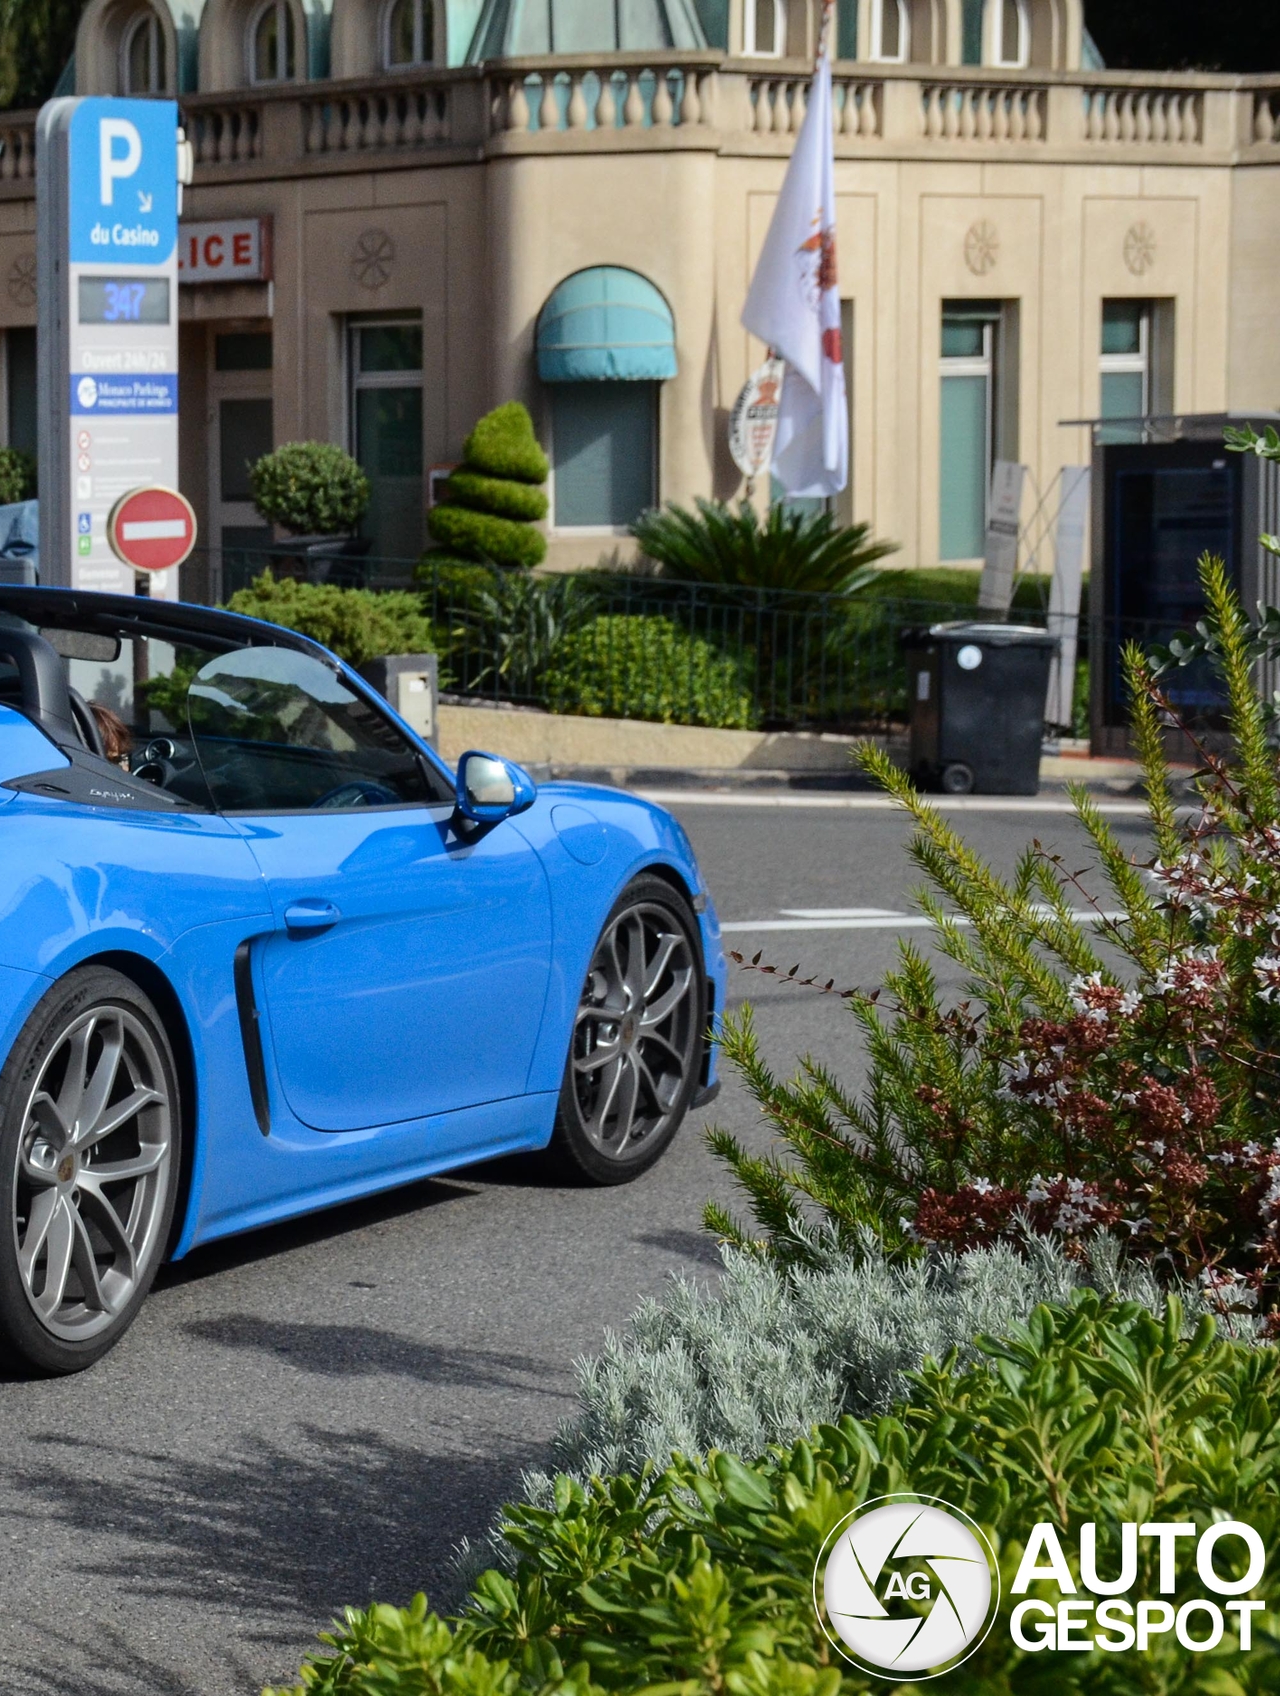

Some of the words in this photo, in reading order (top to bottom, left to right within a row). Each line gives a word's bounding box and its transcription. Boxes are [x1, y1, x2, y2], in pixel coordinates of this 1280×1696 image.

[100, 118, 142, 205] P
[91, 222, 110, 245] du
[112, 223, 159, 247] Casino
[82, 351, 122, 369] Ouvert
[98, 382, 133, 396] Monaco
[133, 382, 169, 399] Parkings
